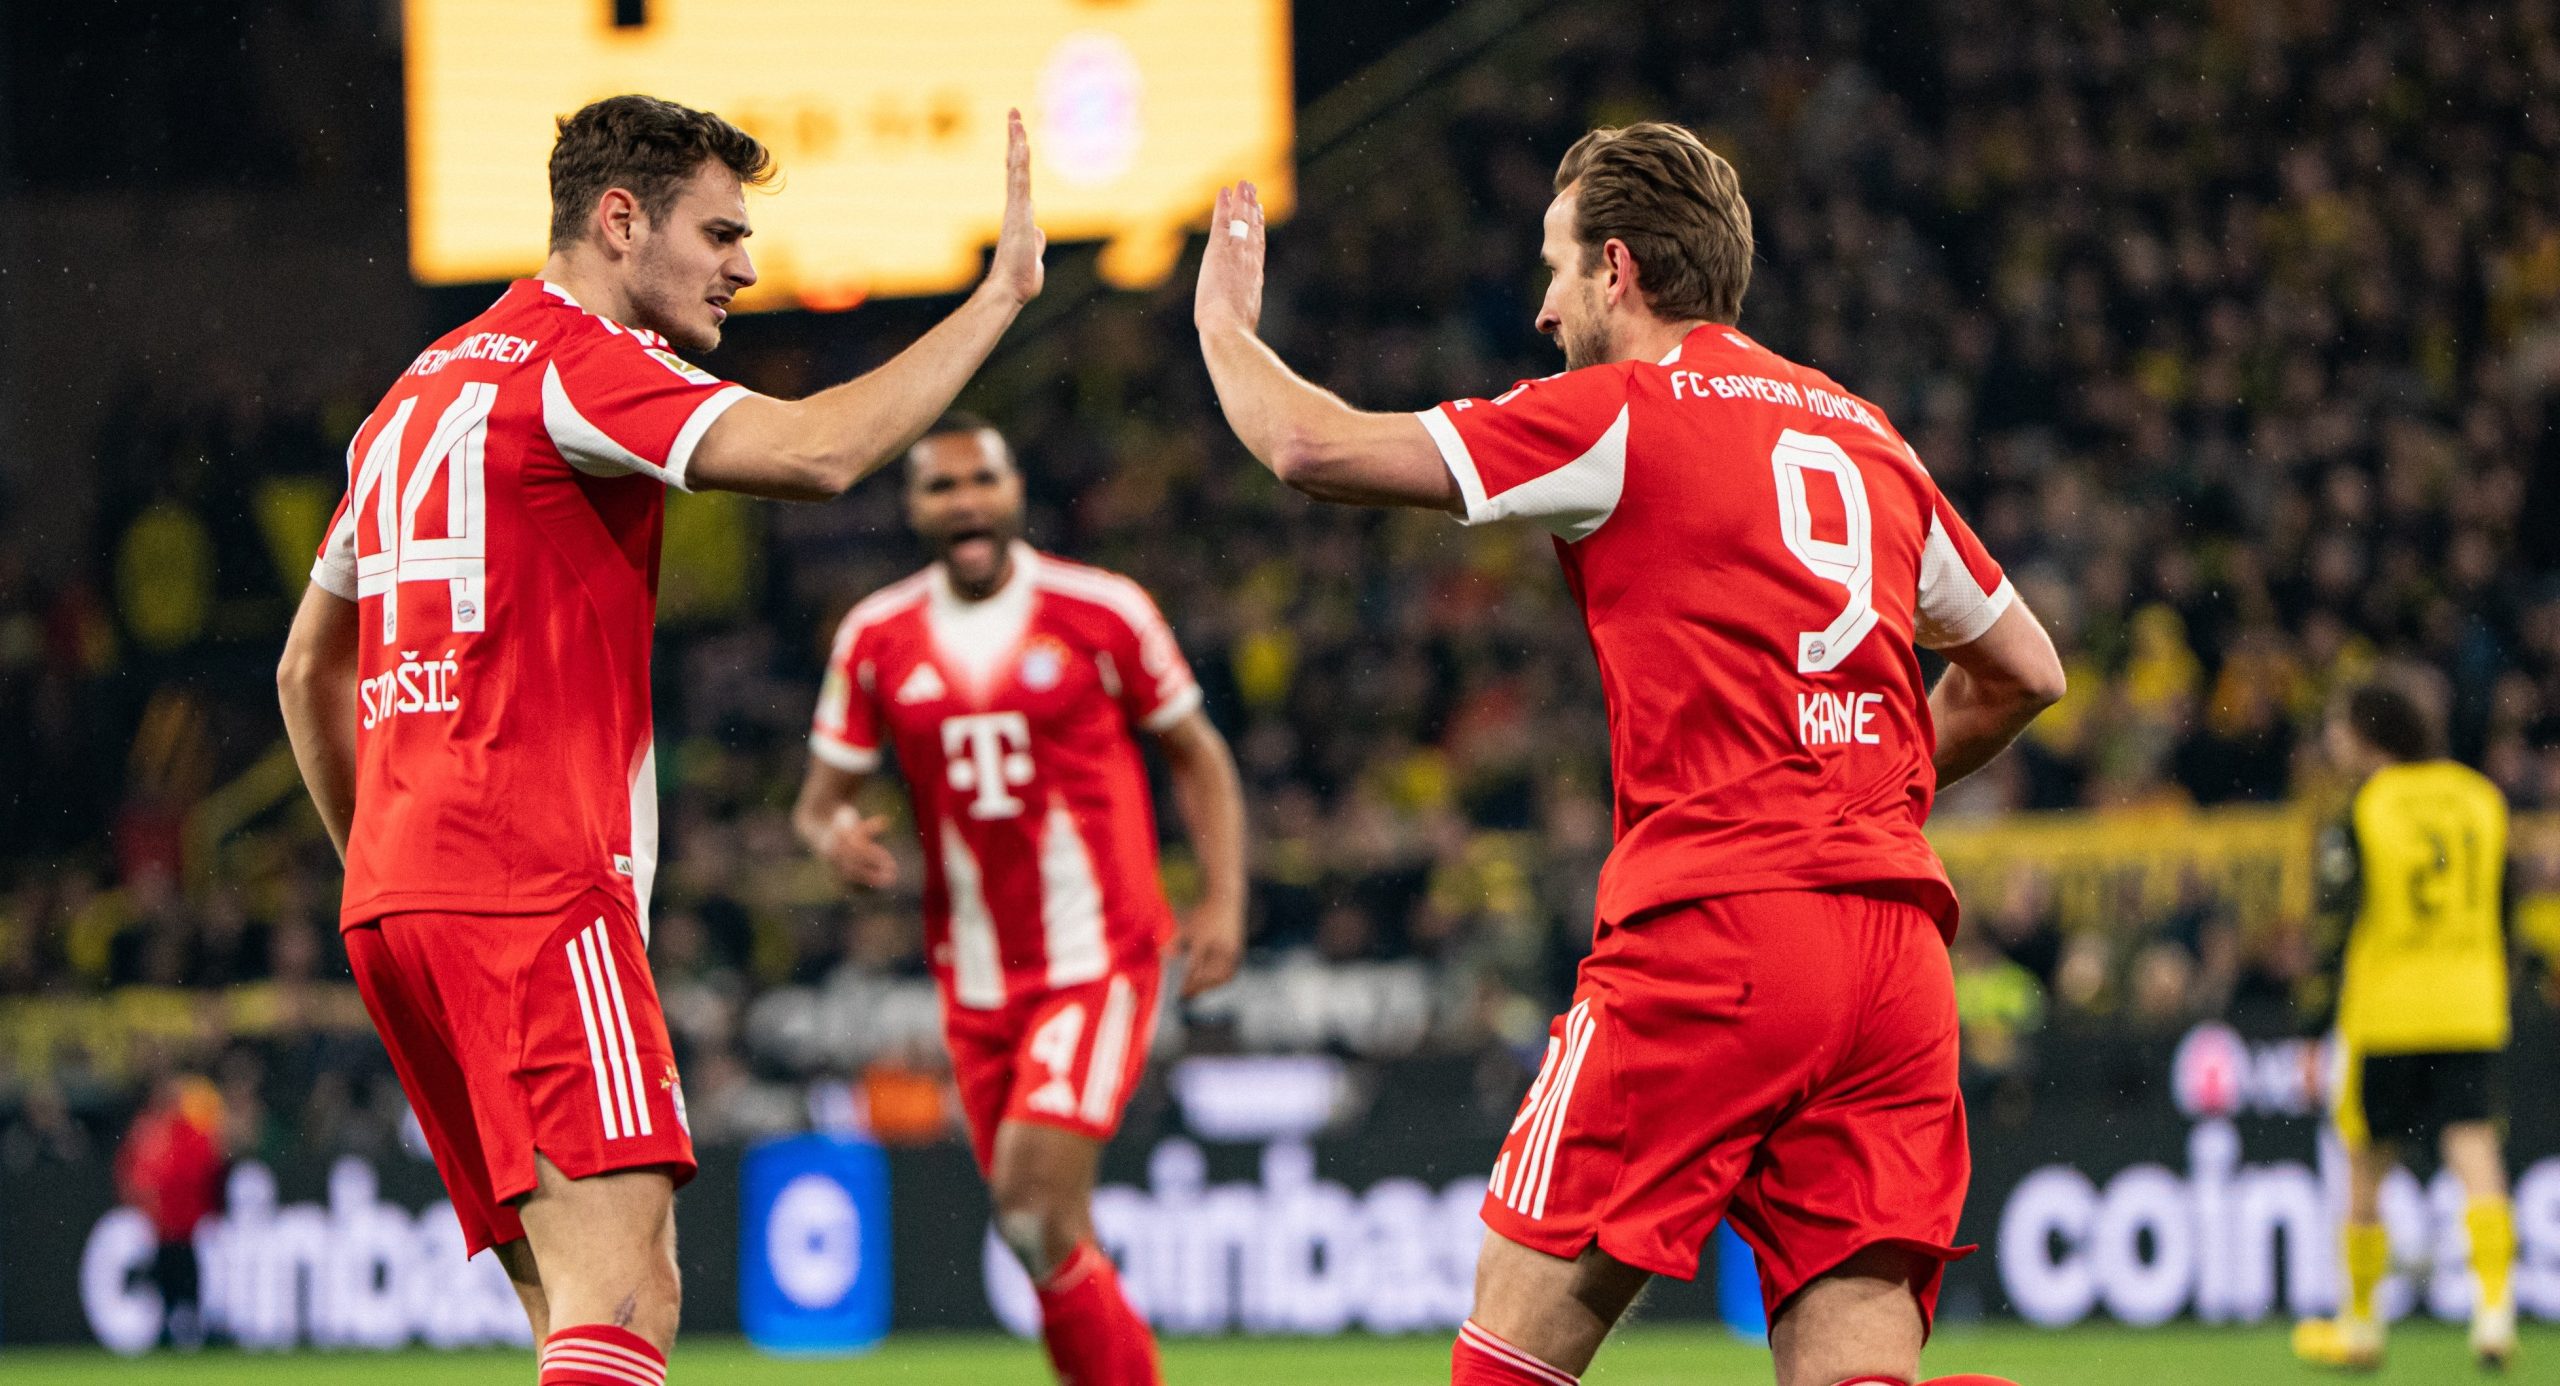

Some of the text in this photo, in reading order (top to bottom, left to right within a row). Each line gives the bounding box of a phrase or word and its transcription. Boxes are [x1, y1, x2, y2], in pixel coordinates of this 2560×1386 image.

[1669, 370, 1889, 440] FC BAYERN MÜNCHE
[353, 381, 498, 646] 44
[1771, 428, 1880, 673] 9
[1797, 691, 1884, 745] KANE
[2405, 823, 2482, 921] 21
[1029, 1003, 1087, 1076] 4
